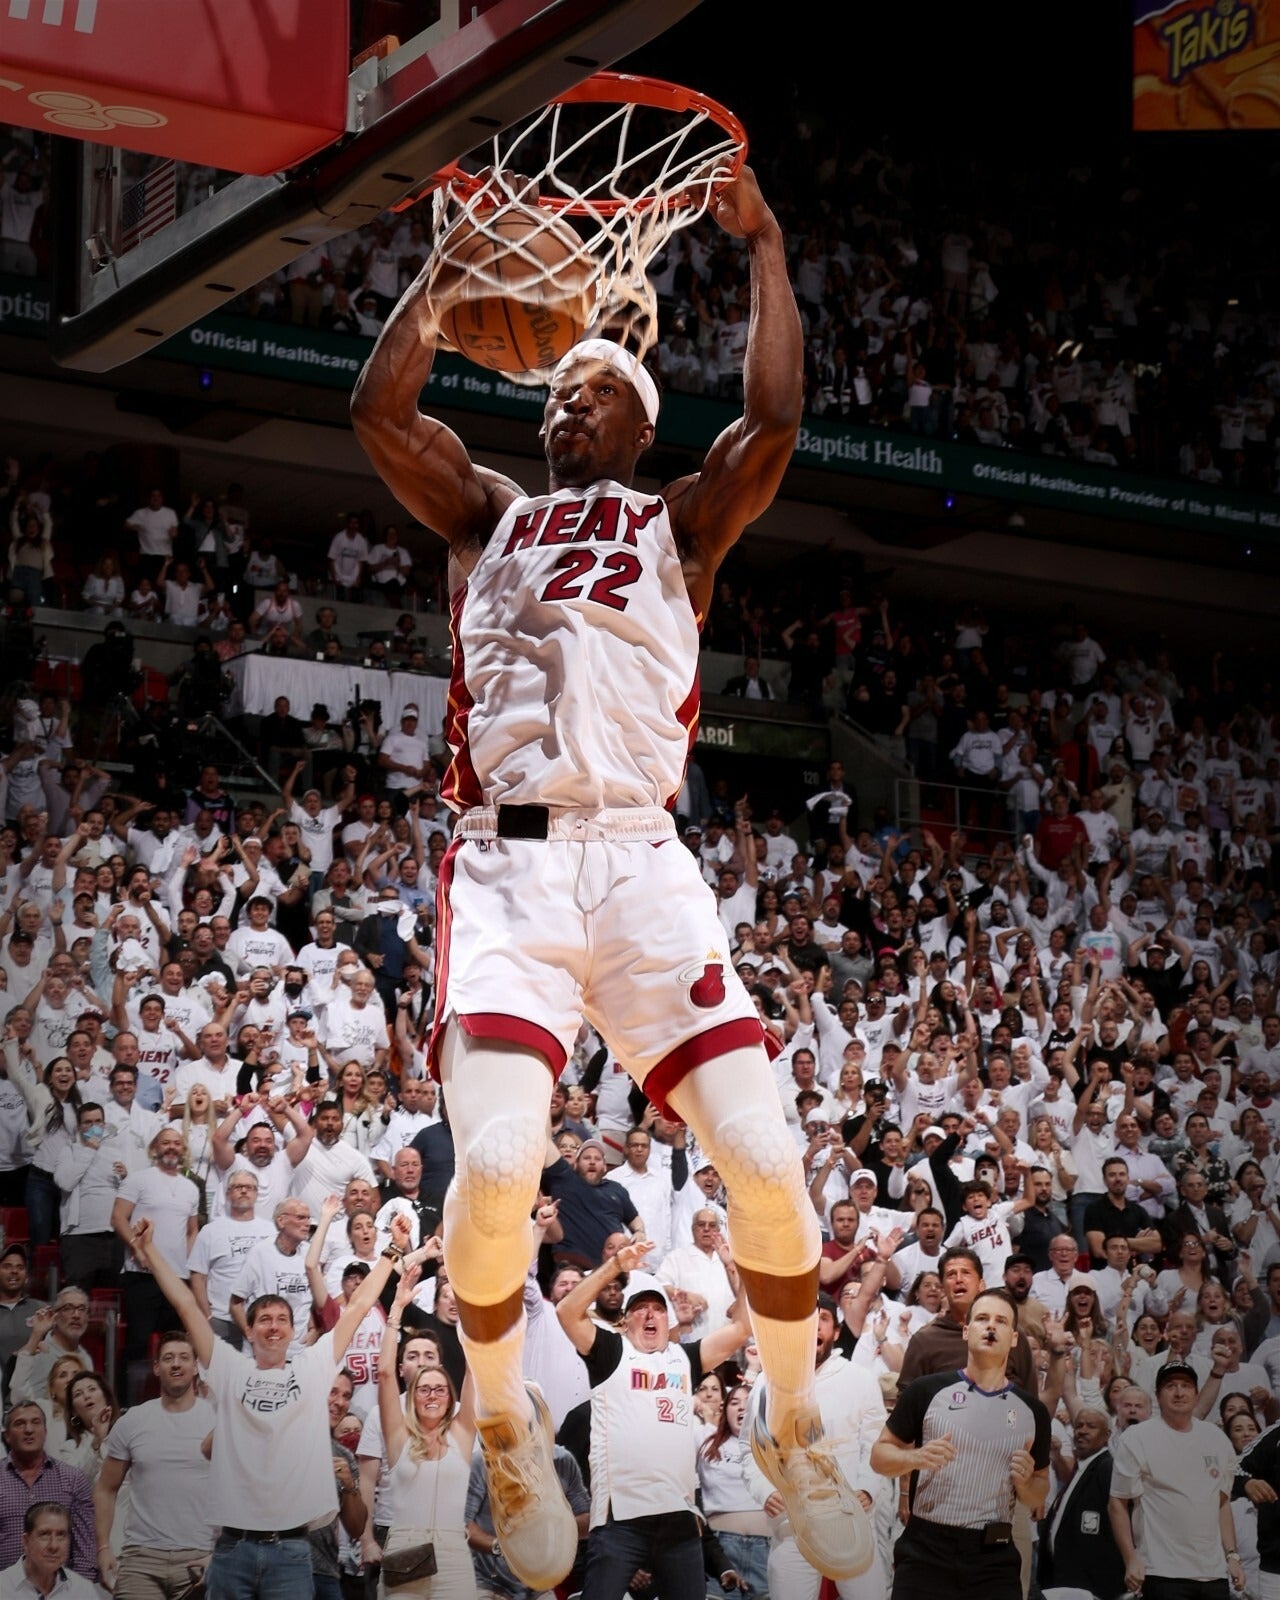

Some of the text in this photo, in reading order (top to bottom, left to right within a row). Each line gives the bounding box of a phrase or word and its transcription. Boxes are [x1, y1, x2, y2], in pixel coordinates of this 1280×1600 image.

[1164, 7, 1250, 79] Takis
[190, 328, 360, 372] Official Healthcare
[441, 374, 459, 388] of
[464, 378, 491, 393] the
[495, 382, 548, 404] Miami
[796, 428, 943, 475] Baptist Health
[972, 463, 1027, 485] Official
[1029, 473, 1107, 498] Healthcare
[1109, 486, 1168, 509] Provider
[1171, 499, 1186, 512] of
[1189, 501, 1211, 516] the
[500, 497, 664, 558] HEAT
[540, 549, 643, 612] 22
[803, 770, 820, 785] 120
[971, 1220, 998, 1245] HEAT
[990, 1234, 1004, 1249] 14
[631, 1368, 688, 1394] MIAMI
[655, 1397, 688, 1427] 22
